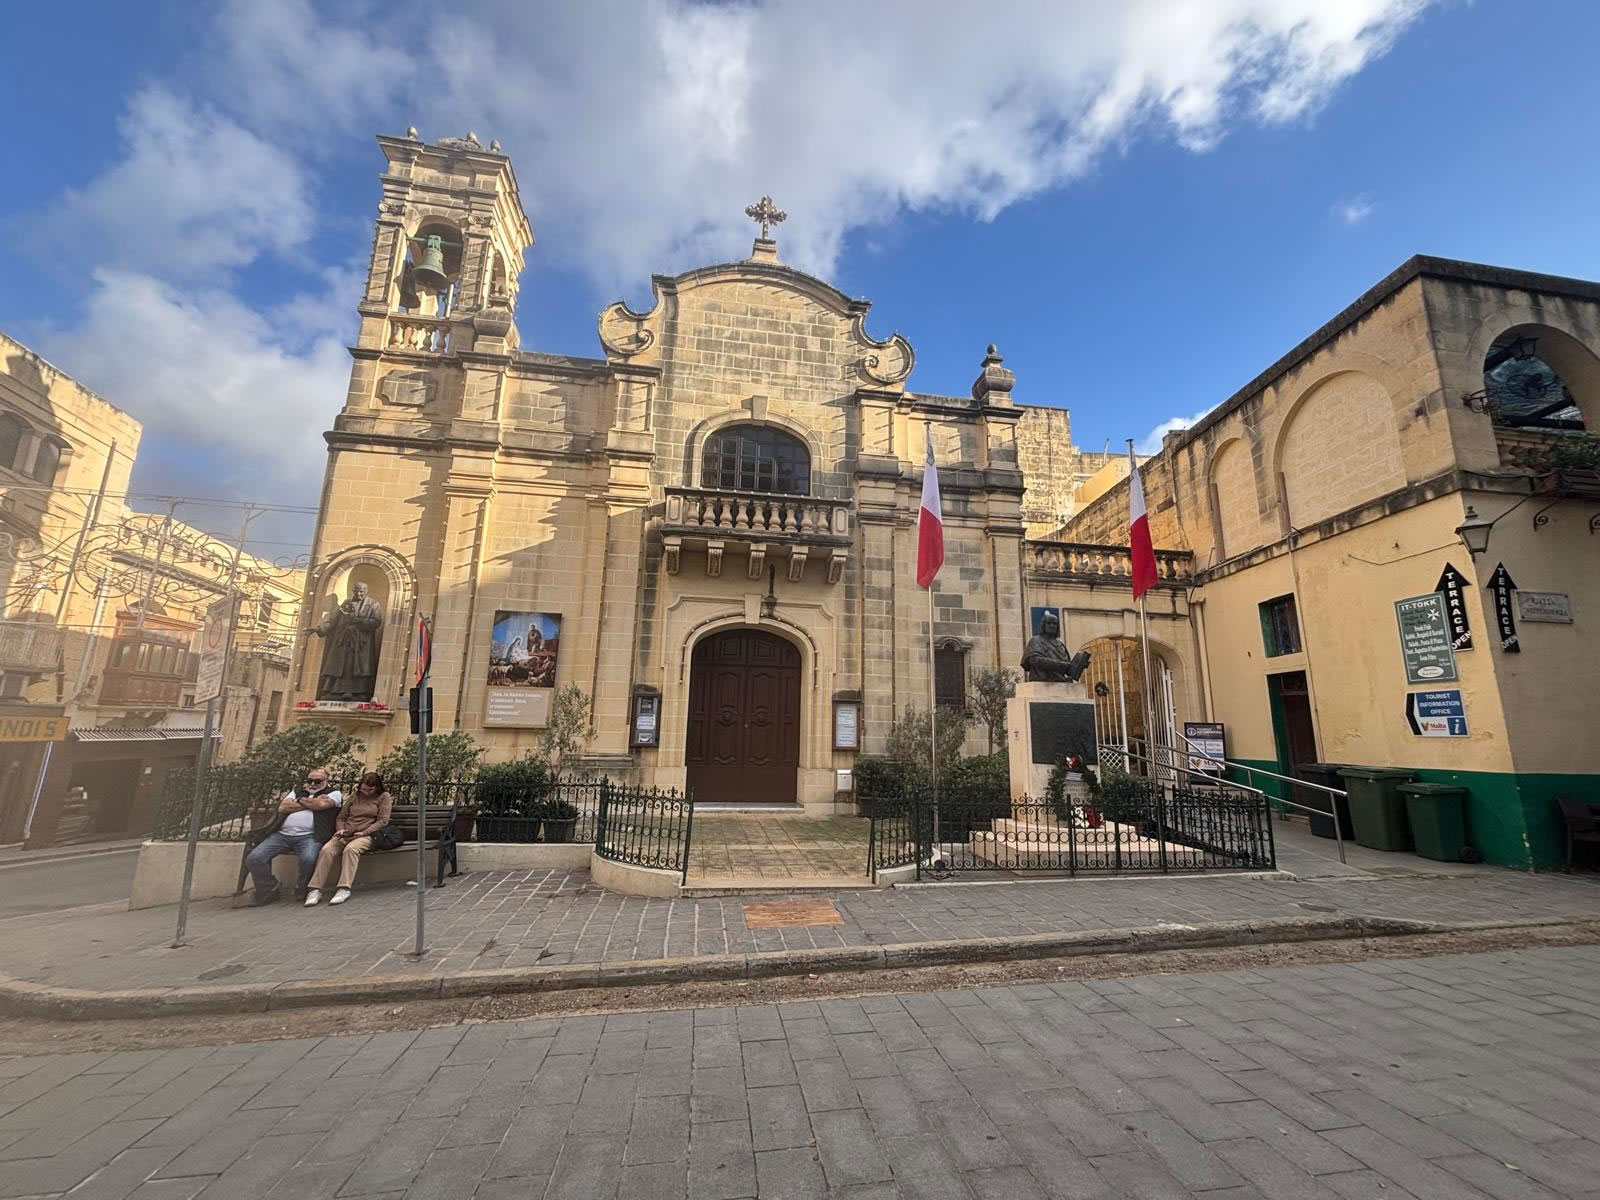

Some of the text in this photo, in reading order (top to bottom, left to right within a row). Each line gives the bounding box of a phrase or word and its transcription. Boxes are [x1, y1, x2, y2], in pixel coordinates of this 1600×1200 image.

[1401, 598, 1437, 611] IT-TOKK
[1446, 572, 1464, 633] TERRACE
[1498, 567, 1511, 634] TERRACE
[1451, 630, 1472, 650] OPEN
[1501, 634, 1518, 649] OPEN
